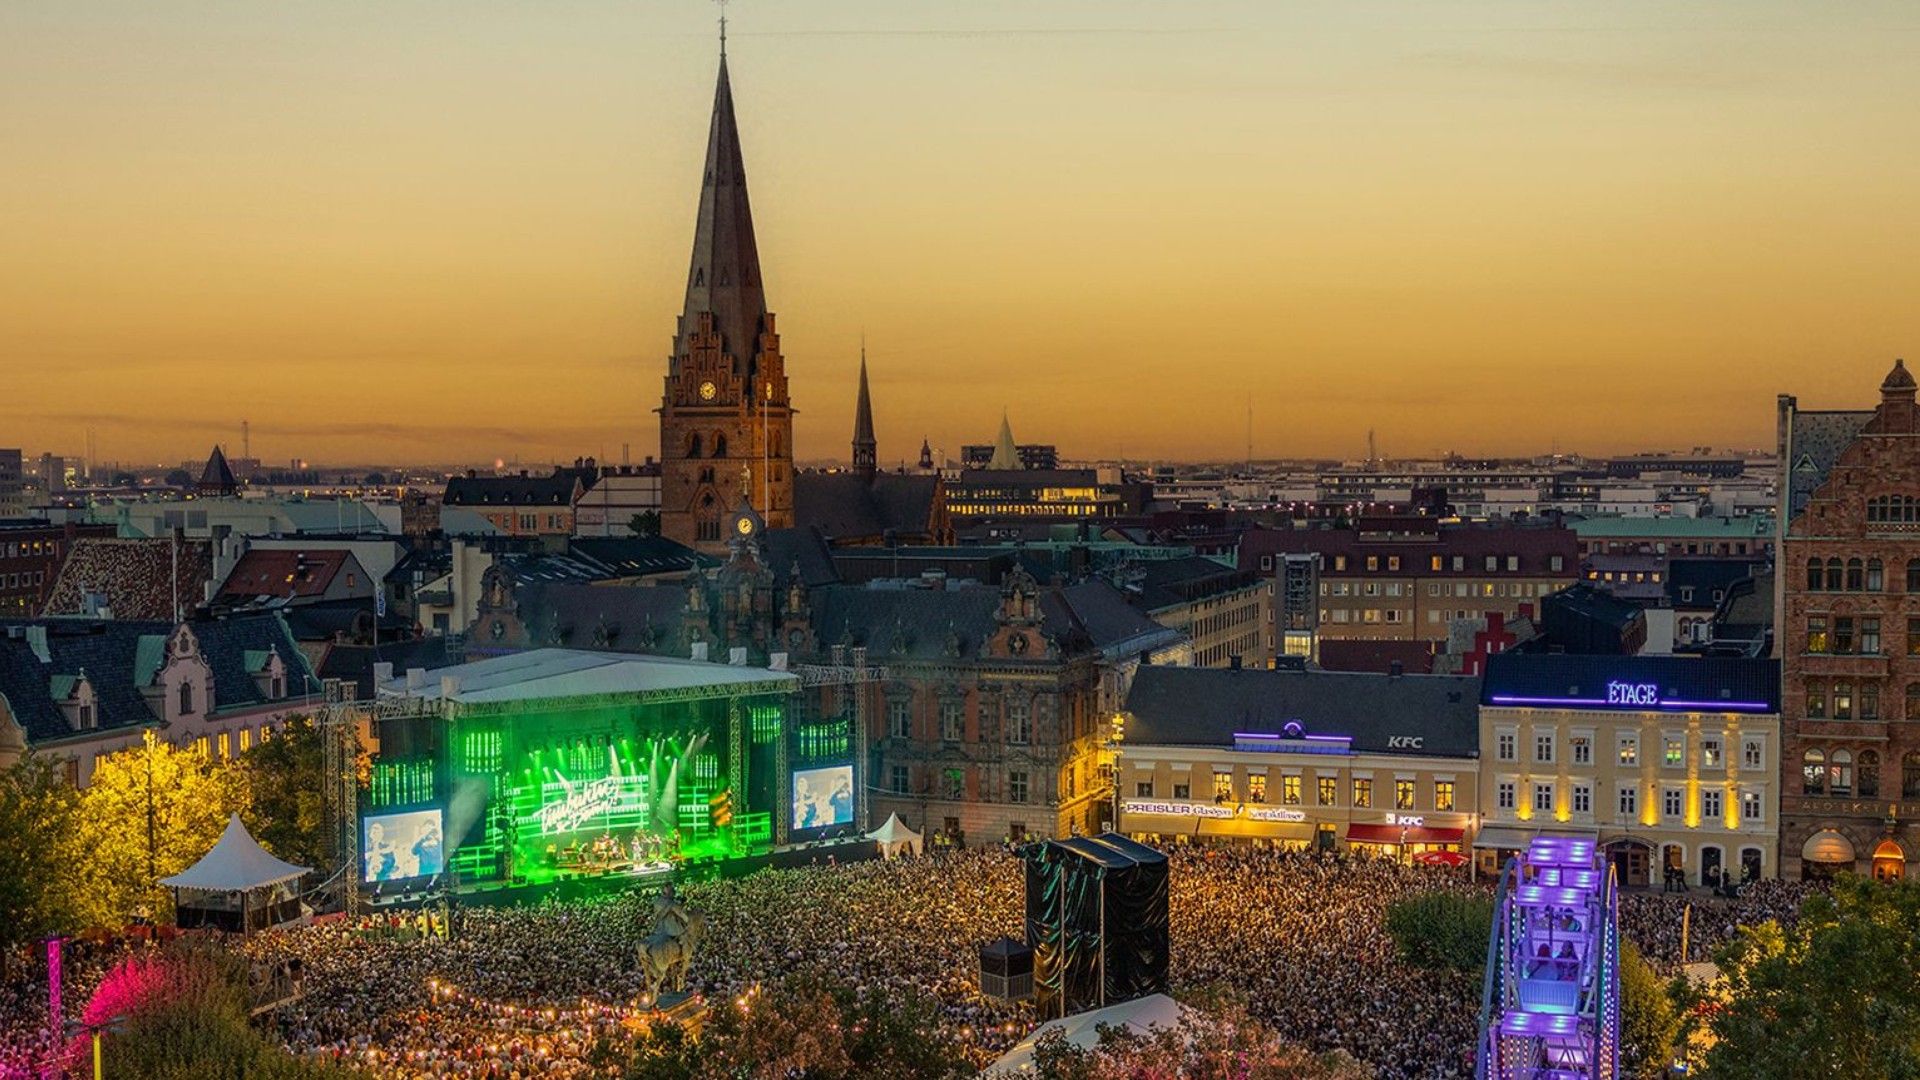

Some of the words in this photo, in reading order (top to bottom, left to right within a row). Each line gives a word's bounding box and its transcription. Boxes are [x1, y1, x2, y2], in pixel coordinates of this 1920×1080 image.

[1608, 680, 1657, 704] ÉTAGE
[1387, 736, 1424, 749] KFC
[1127, 804, 1190, 814] PREISLER
[1398, 816, 1424, 826] KFC
